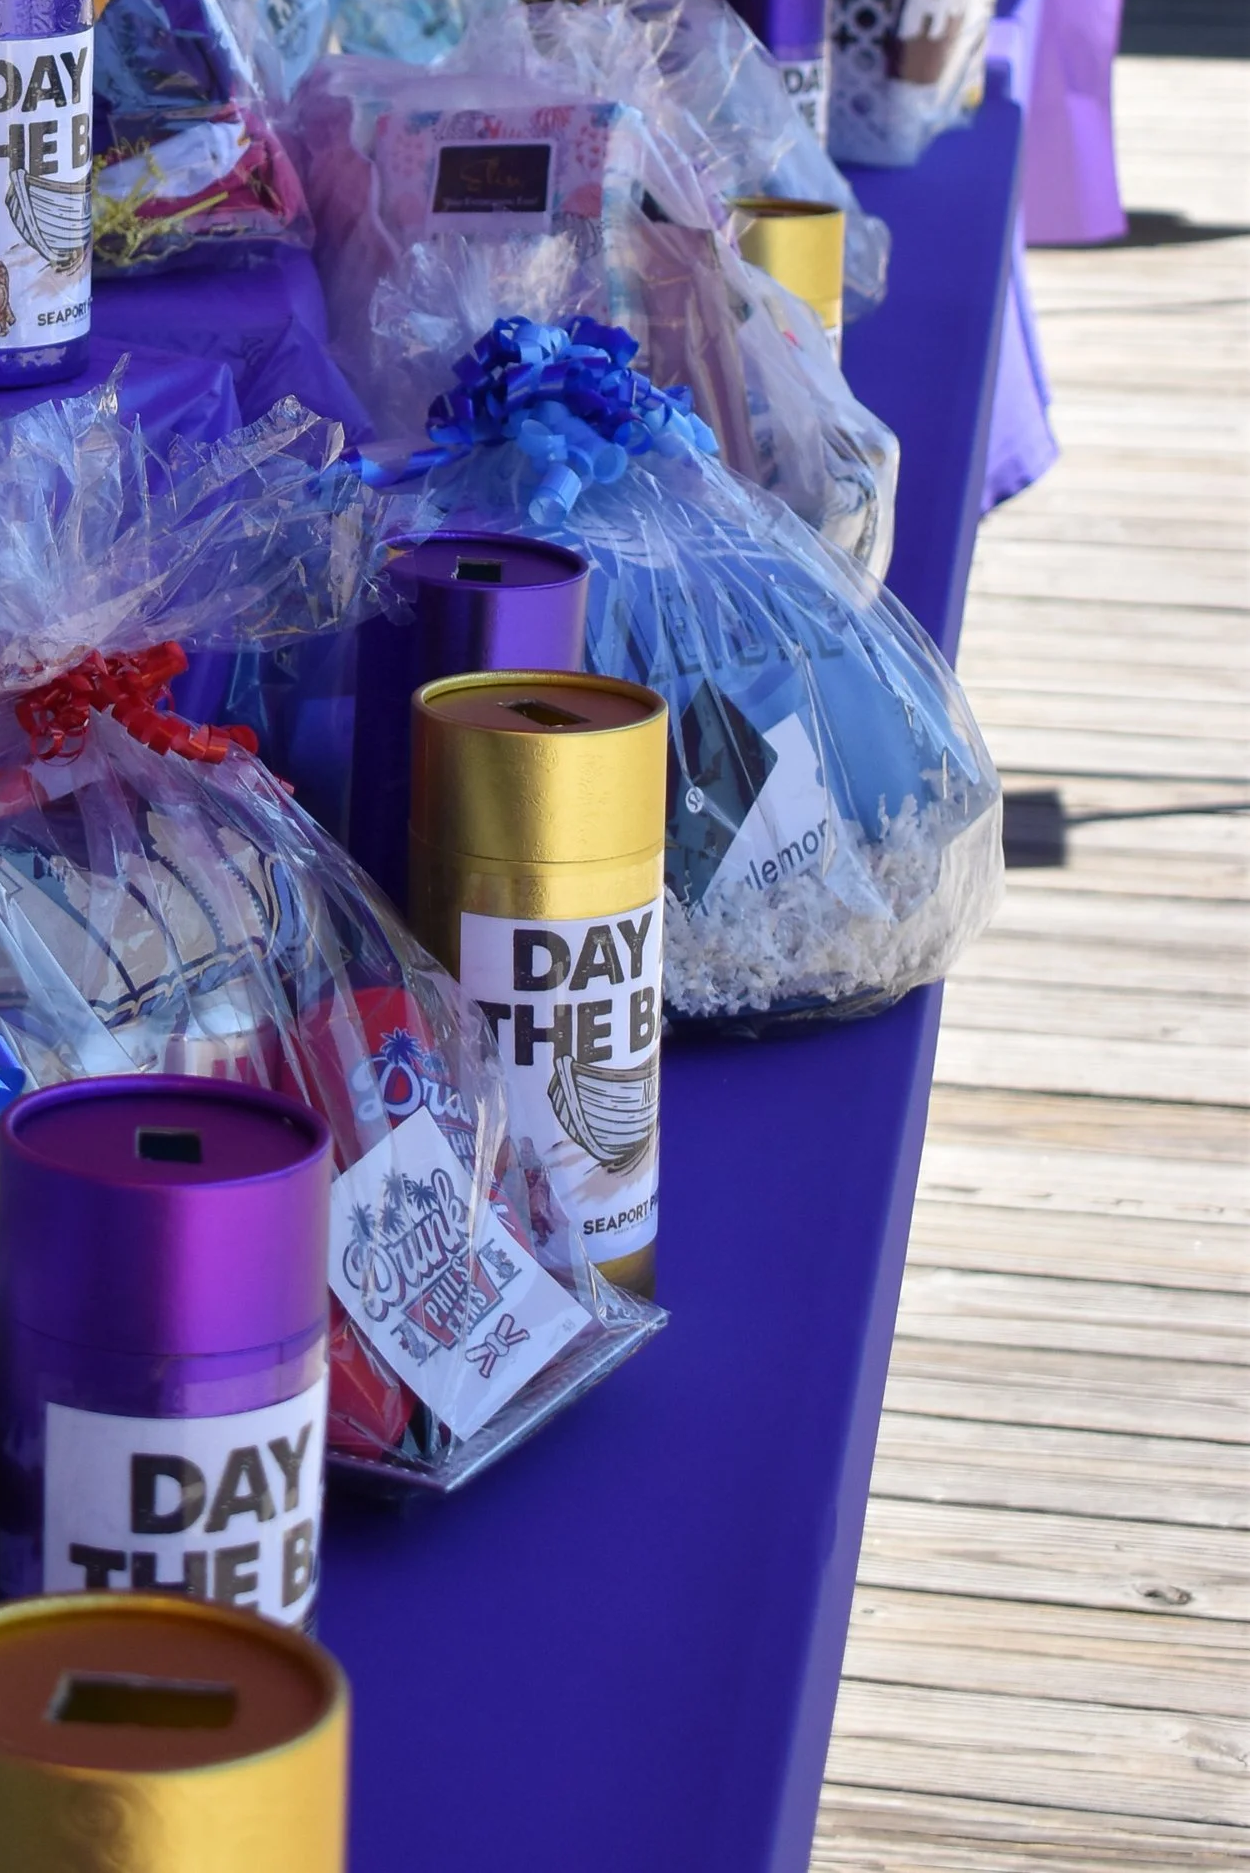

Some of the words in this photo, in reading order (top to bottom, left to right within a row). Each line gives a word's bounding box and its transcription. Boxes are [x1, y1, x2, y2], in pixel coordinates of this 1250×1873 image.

[71, 113, 91, 169] B
[37, 300, 88, 327] SEAPORT
[745, 818, 828, 892] lemo
[513, 911, 653, 991] DAY
[476, 998, 613, 1066] THE
[629, 986, 660, 1054] B
[583, 1199, 649, 1236] SEAPORT
[131, 1420, 313, 1534] DAY
[69, 1541, 260, 1610] THE
[281, 1517, 314, 1608] B
